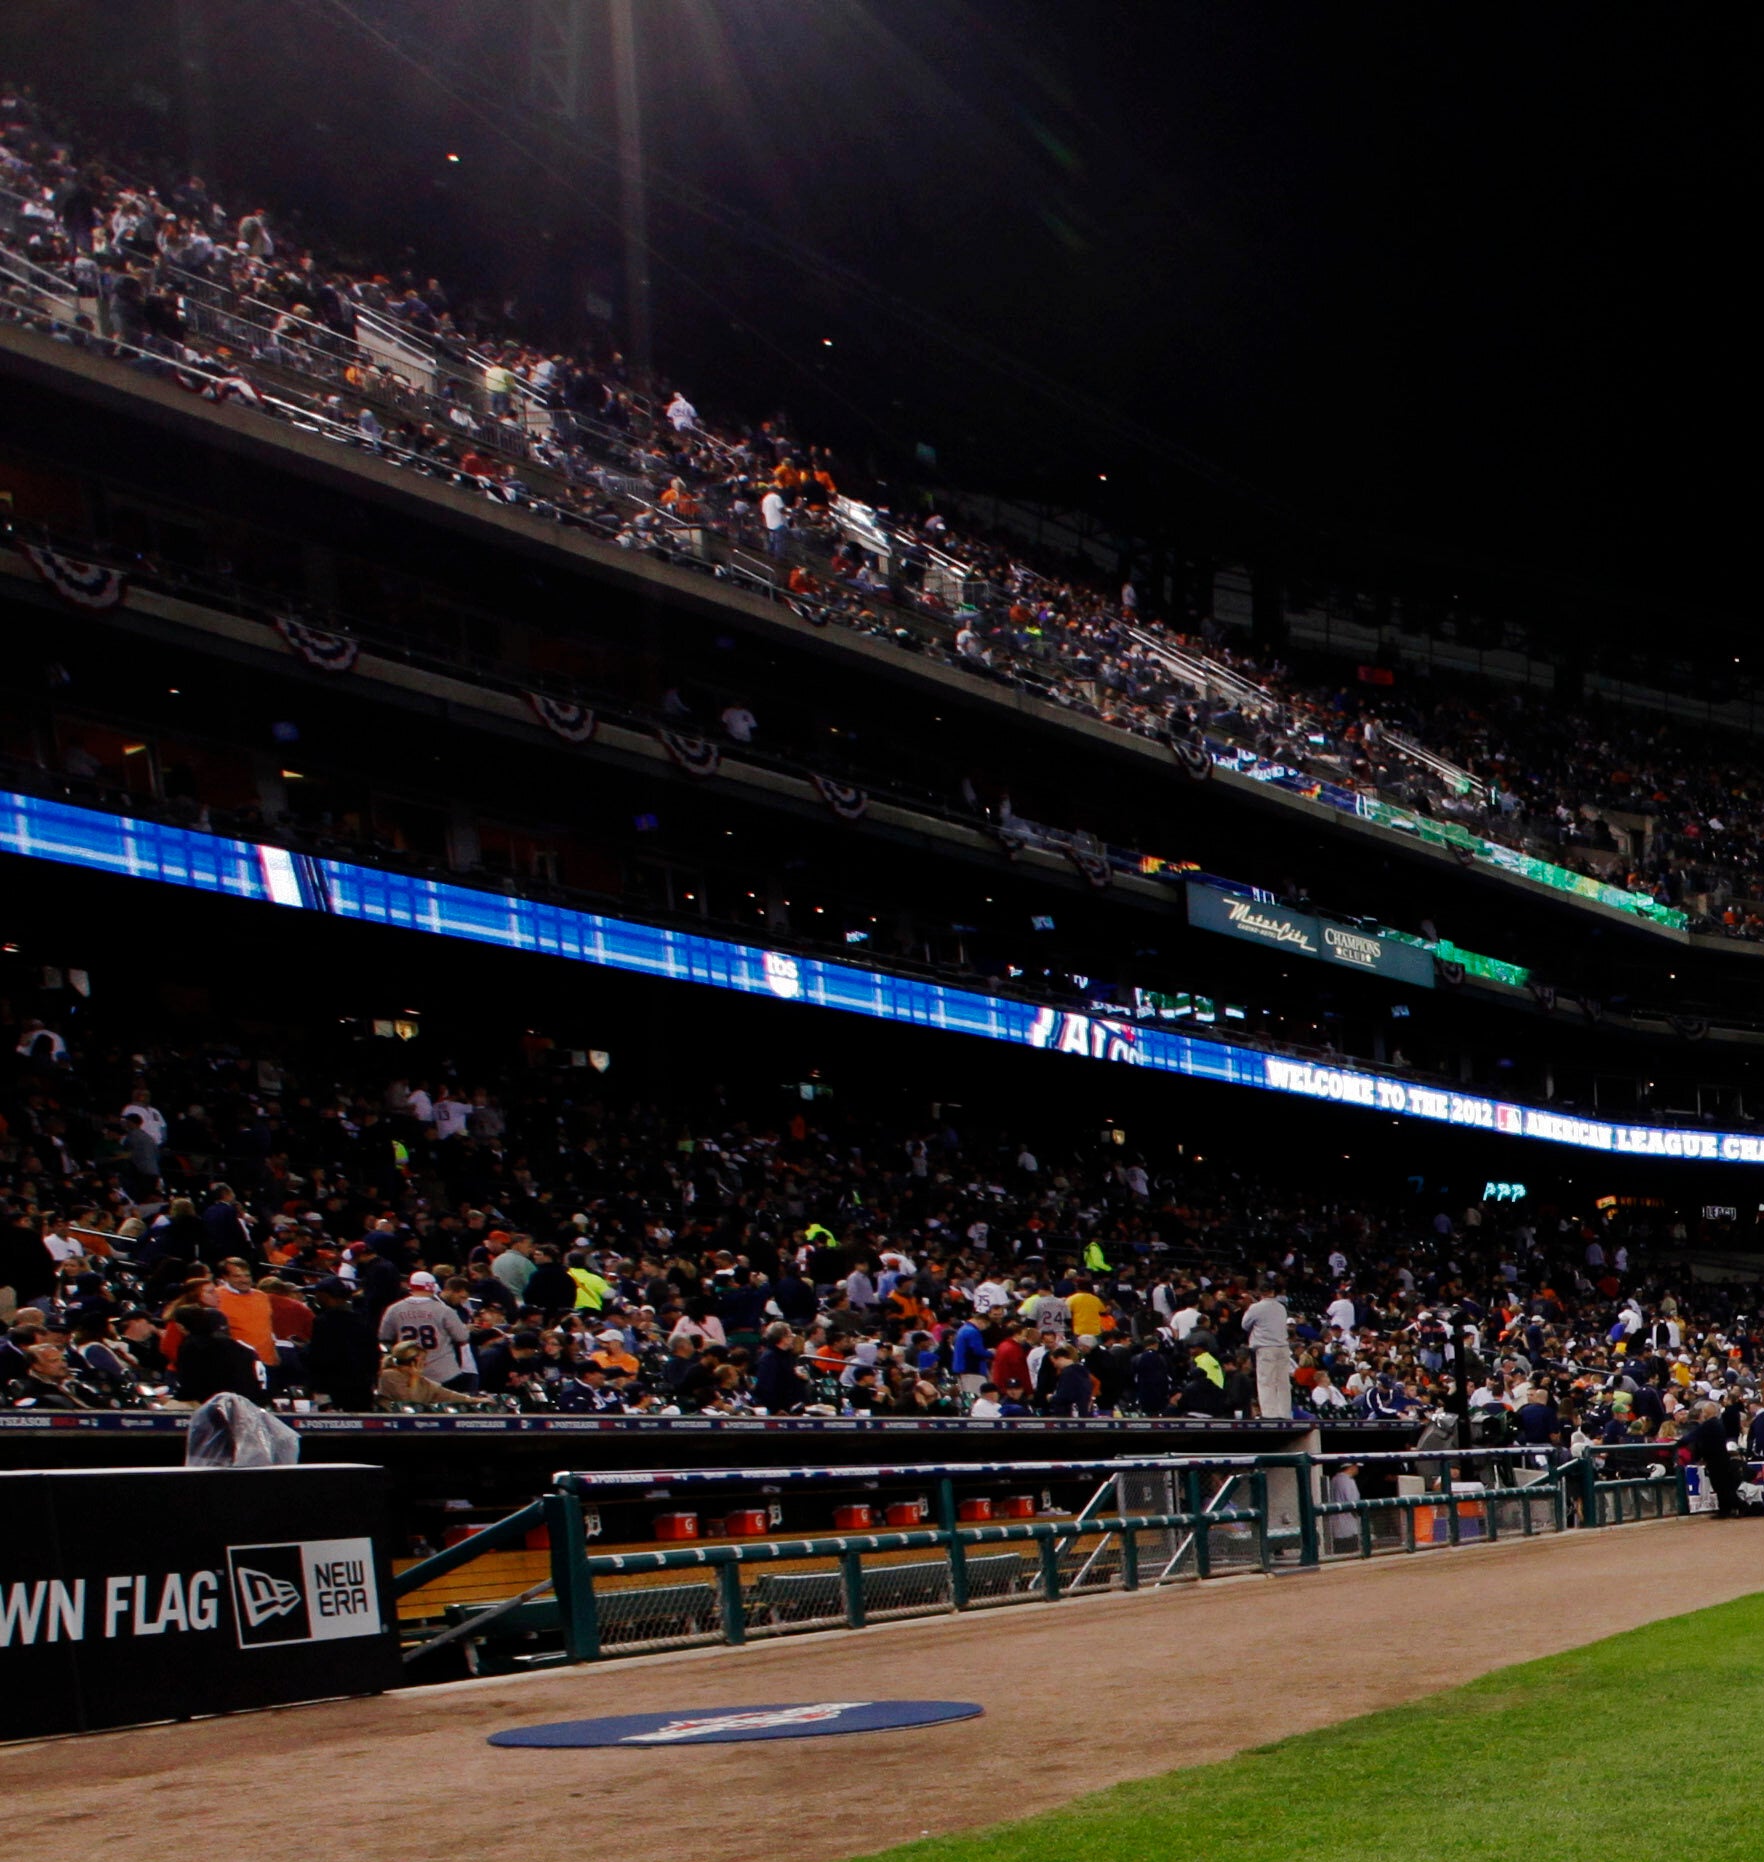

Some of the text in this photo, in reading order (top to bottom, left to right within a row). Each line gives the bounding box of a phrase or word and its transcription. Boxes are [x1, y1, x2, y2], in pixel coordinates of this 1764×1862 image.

[1325, 928, 1382, 958] CHAMPIONS
[1342, 947, 1366, 962] CLUB
[768, 952, 798, 978] tbs
[1265, 1058, 1374, 1102] WELCOME
[1379, 1082, 1405, 1111] TO
[1409, 1088, 1448, 1118] THE
[1452, 1098, 1493, 1127] 2012
[1527, 1112, 1611, 1150] AMERICAN
[1616, 1124, 1719, 1159] LEAGUE
[1042, 1311, 1063, 1325] 24
[401, 1324, 438, 1349] 28
[314, 1560, 364, 1589] NEW
[105, 1570, 218, 1639] FLAG
[318, 1588, 369, 1617] ERA
